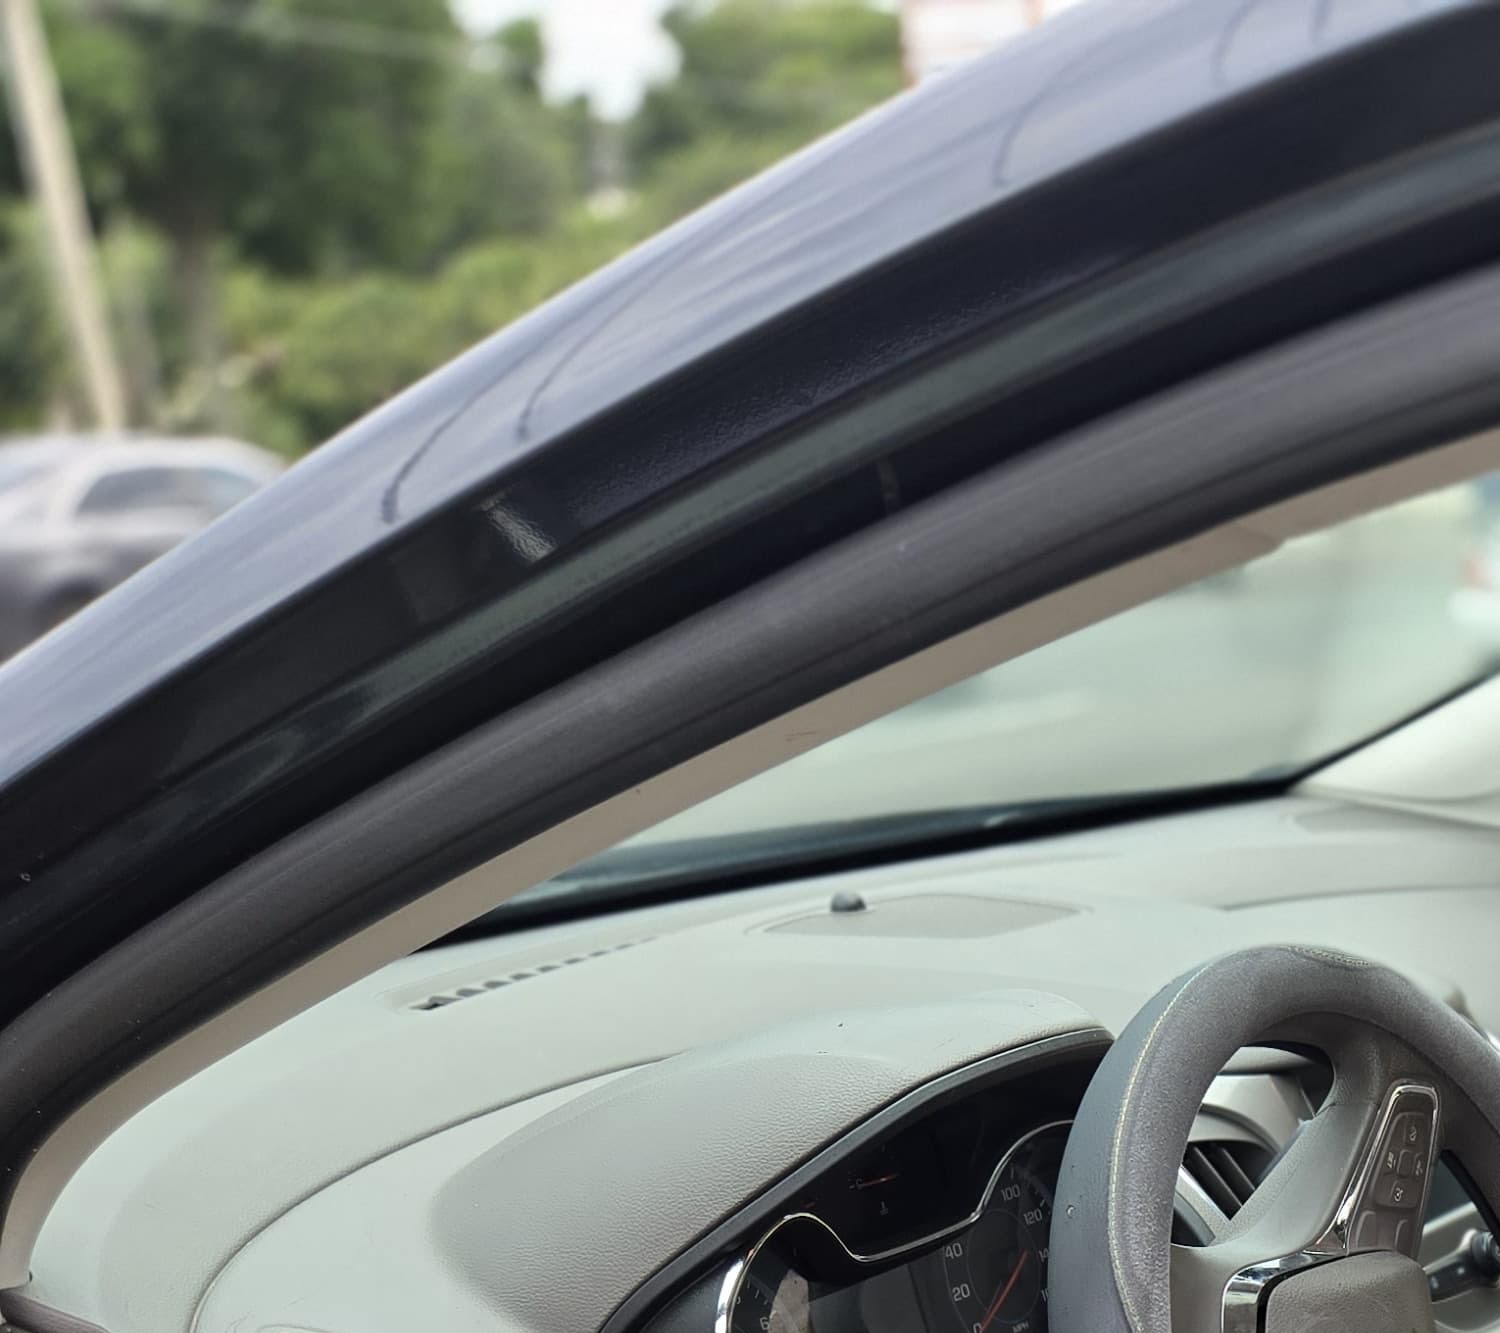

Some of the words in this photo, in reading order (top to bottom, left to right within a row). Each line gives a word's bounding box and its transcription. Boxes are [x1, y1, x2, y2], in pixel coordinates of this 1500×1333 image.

[1001, 1184, 1021, 1200] 100
[1023, 1208, 1043, 1225] 120
[945, 1242, 963, 1259] 40
[952, 1283, 971, 1301] 20
[759, 1315, 770, 1330] 6
